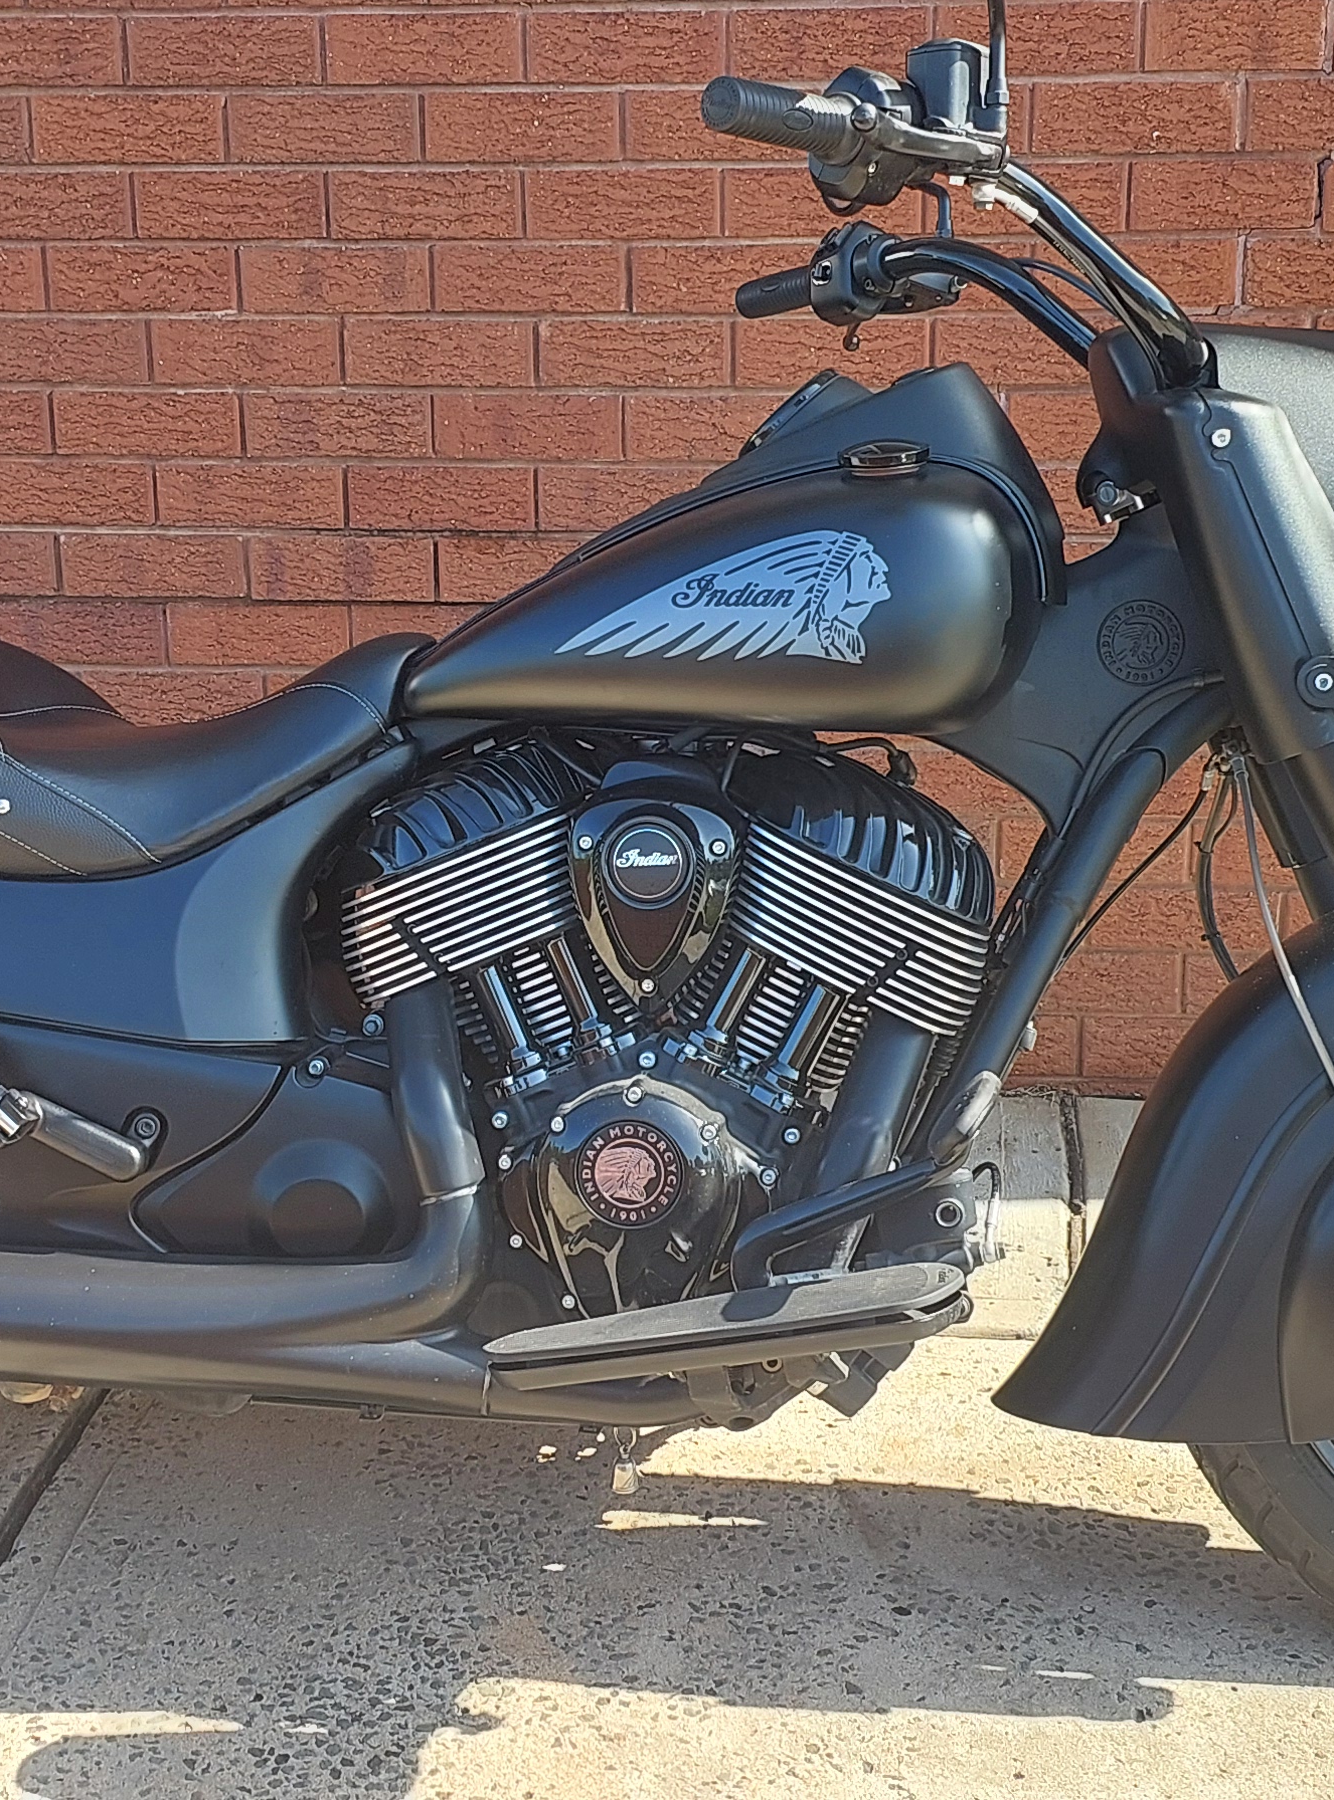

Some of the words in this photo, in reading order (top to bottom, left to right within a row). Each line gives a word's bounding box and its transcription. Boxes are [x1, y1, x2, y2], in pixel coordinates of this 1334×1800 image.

[671, 573, 795, 609] Indian
[1102, 614, 1122, 666] INDIAN
[616, 848, 678, 868] Indian
[582, 1136, 605, 1201] INDIAN
[609, 1125, 677, 1206] MOTORCYCLE
[610, 1207, 646, 1221] 1901
